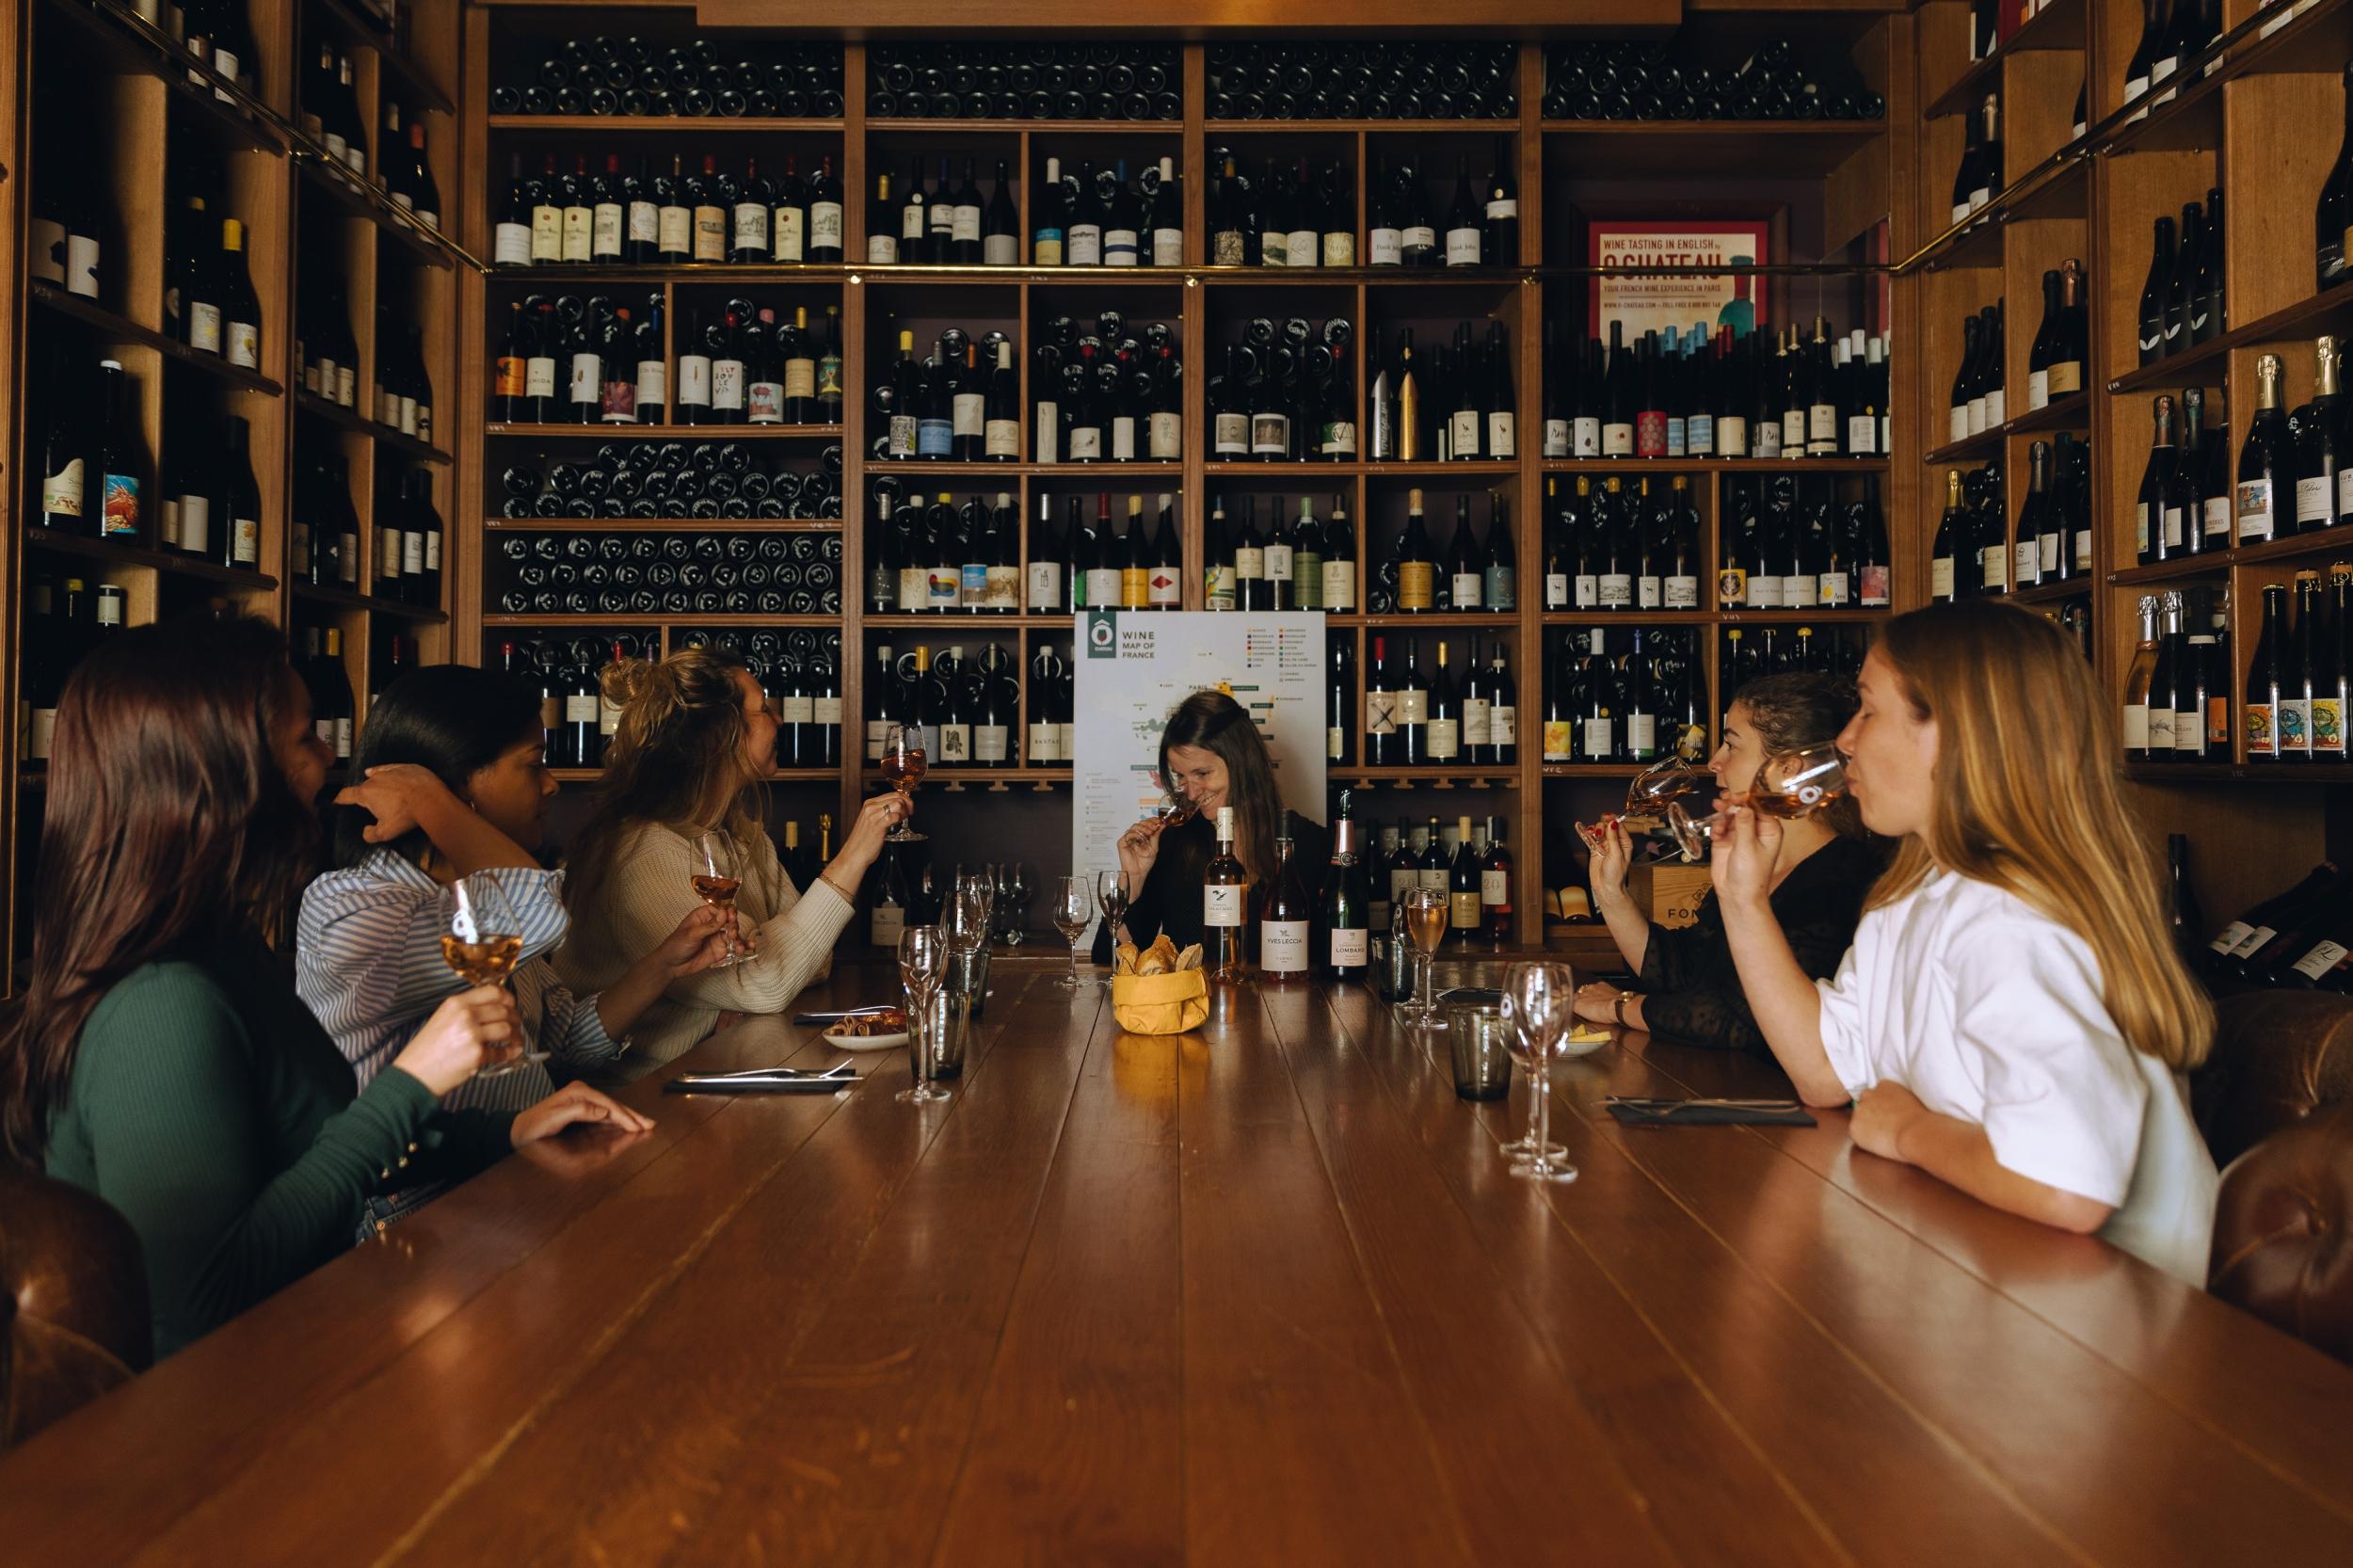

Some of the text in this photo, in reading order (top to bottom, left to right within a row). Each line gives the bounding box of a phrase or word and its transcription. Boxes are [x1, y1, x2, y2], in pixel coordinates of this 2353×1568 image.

[1604, 240, 1625, 249] WINE
[1628, 240, 1663, 249] TASTING
[1665, 240, 1674, 249] IN
[1677, 240, 1714, 249] ENGLISH
[1122, 632, 1155, 640] WINE
